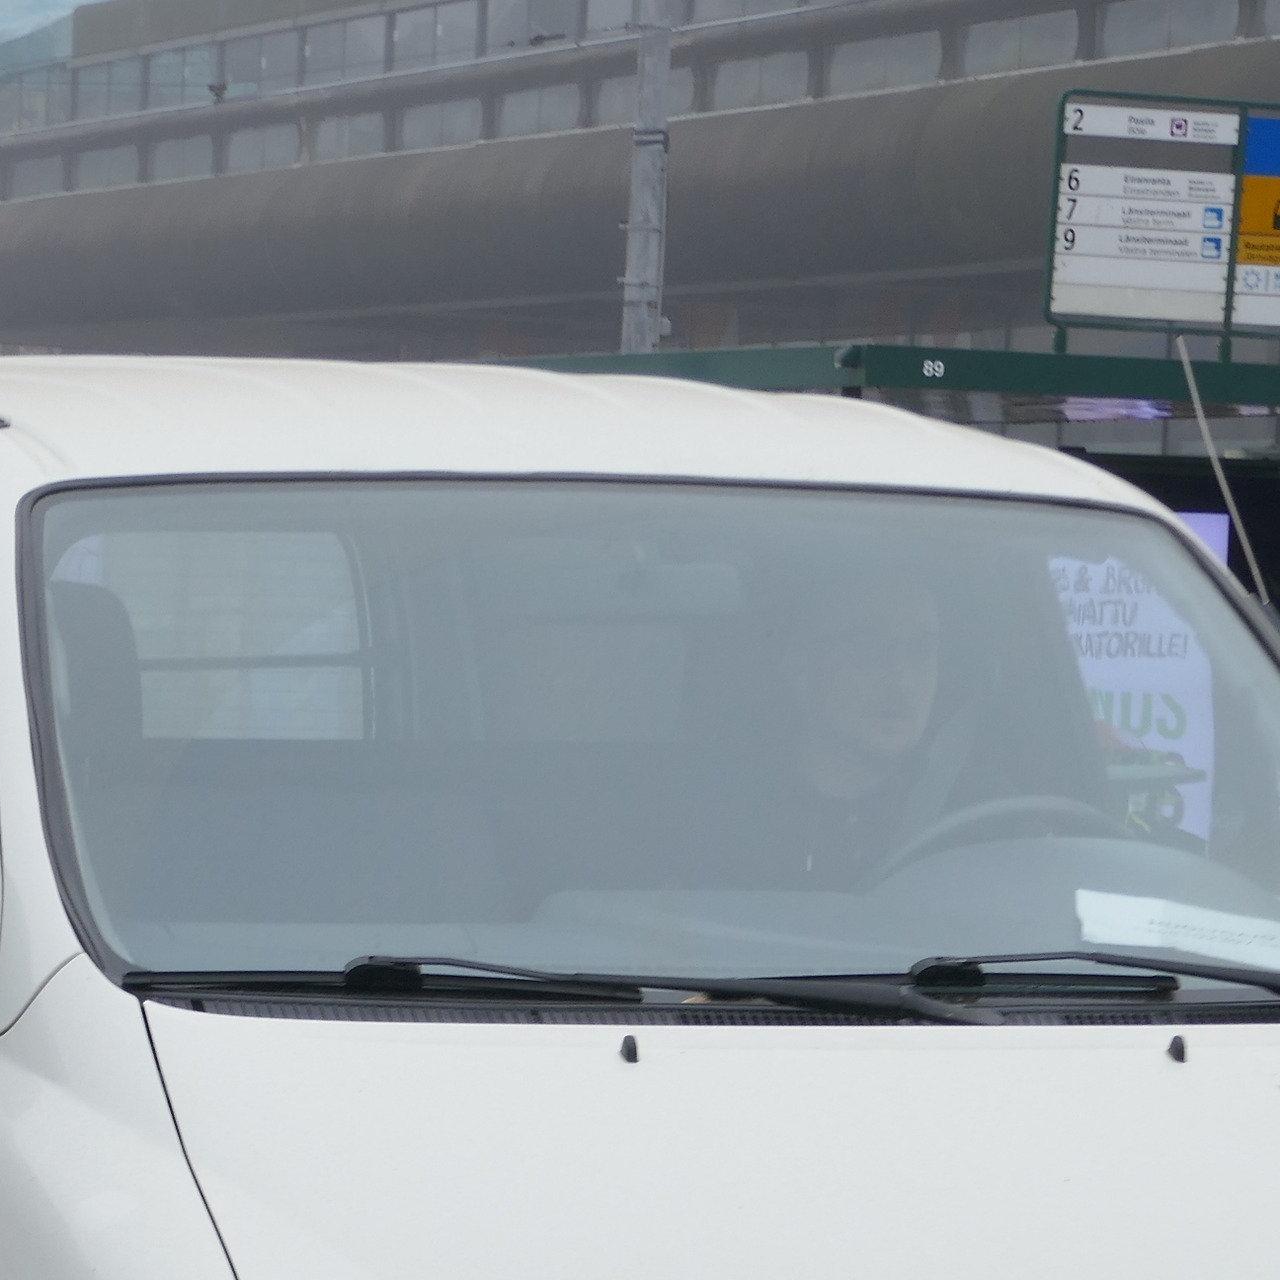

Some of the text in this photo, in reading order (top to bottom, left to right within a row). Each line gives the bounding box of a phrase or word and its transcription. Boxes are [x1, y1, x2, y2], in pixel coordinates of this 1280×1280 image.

[1073, 109, 1084, 131] 2
[1068, 168, 1080, 191] 6
[1067, 198, 1078, 221] 7
[1063, 228, 1076, 251] 9
[922, 359, 945, 378] 89
